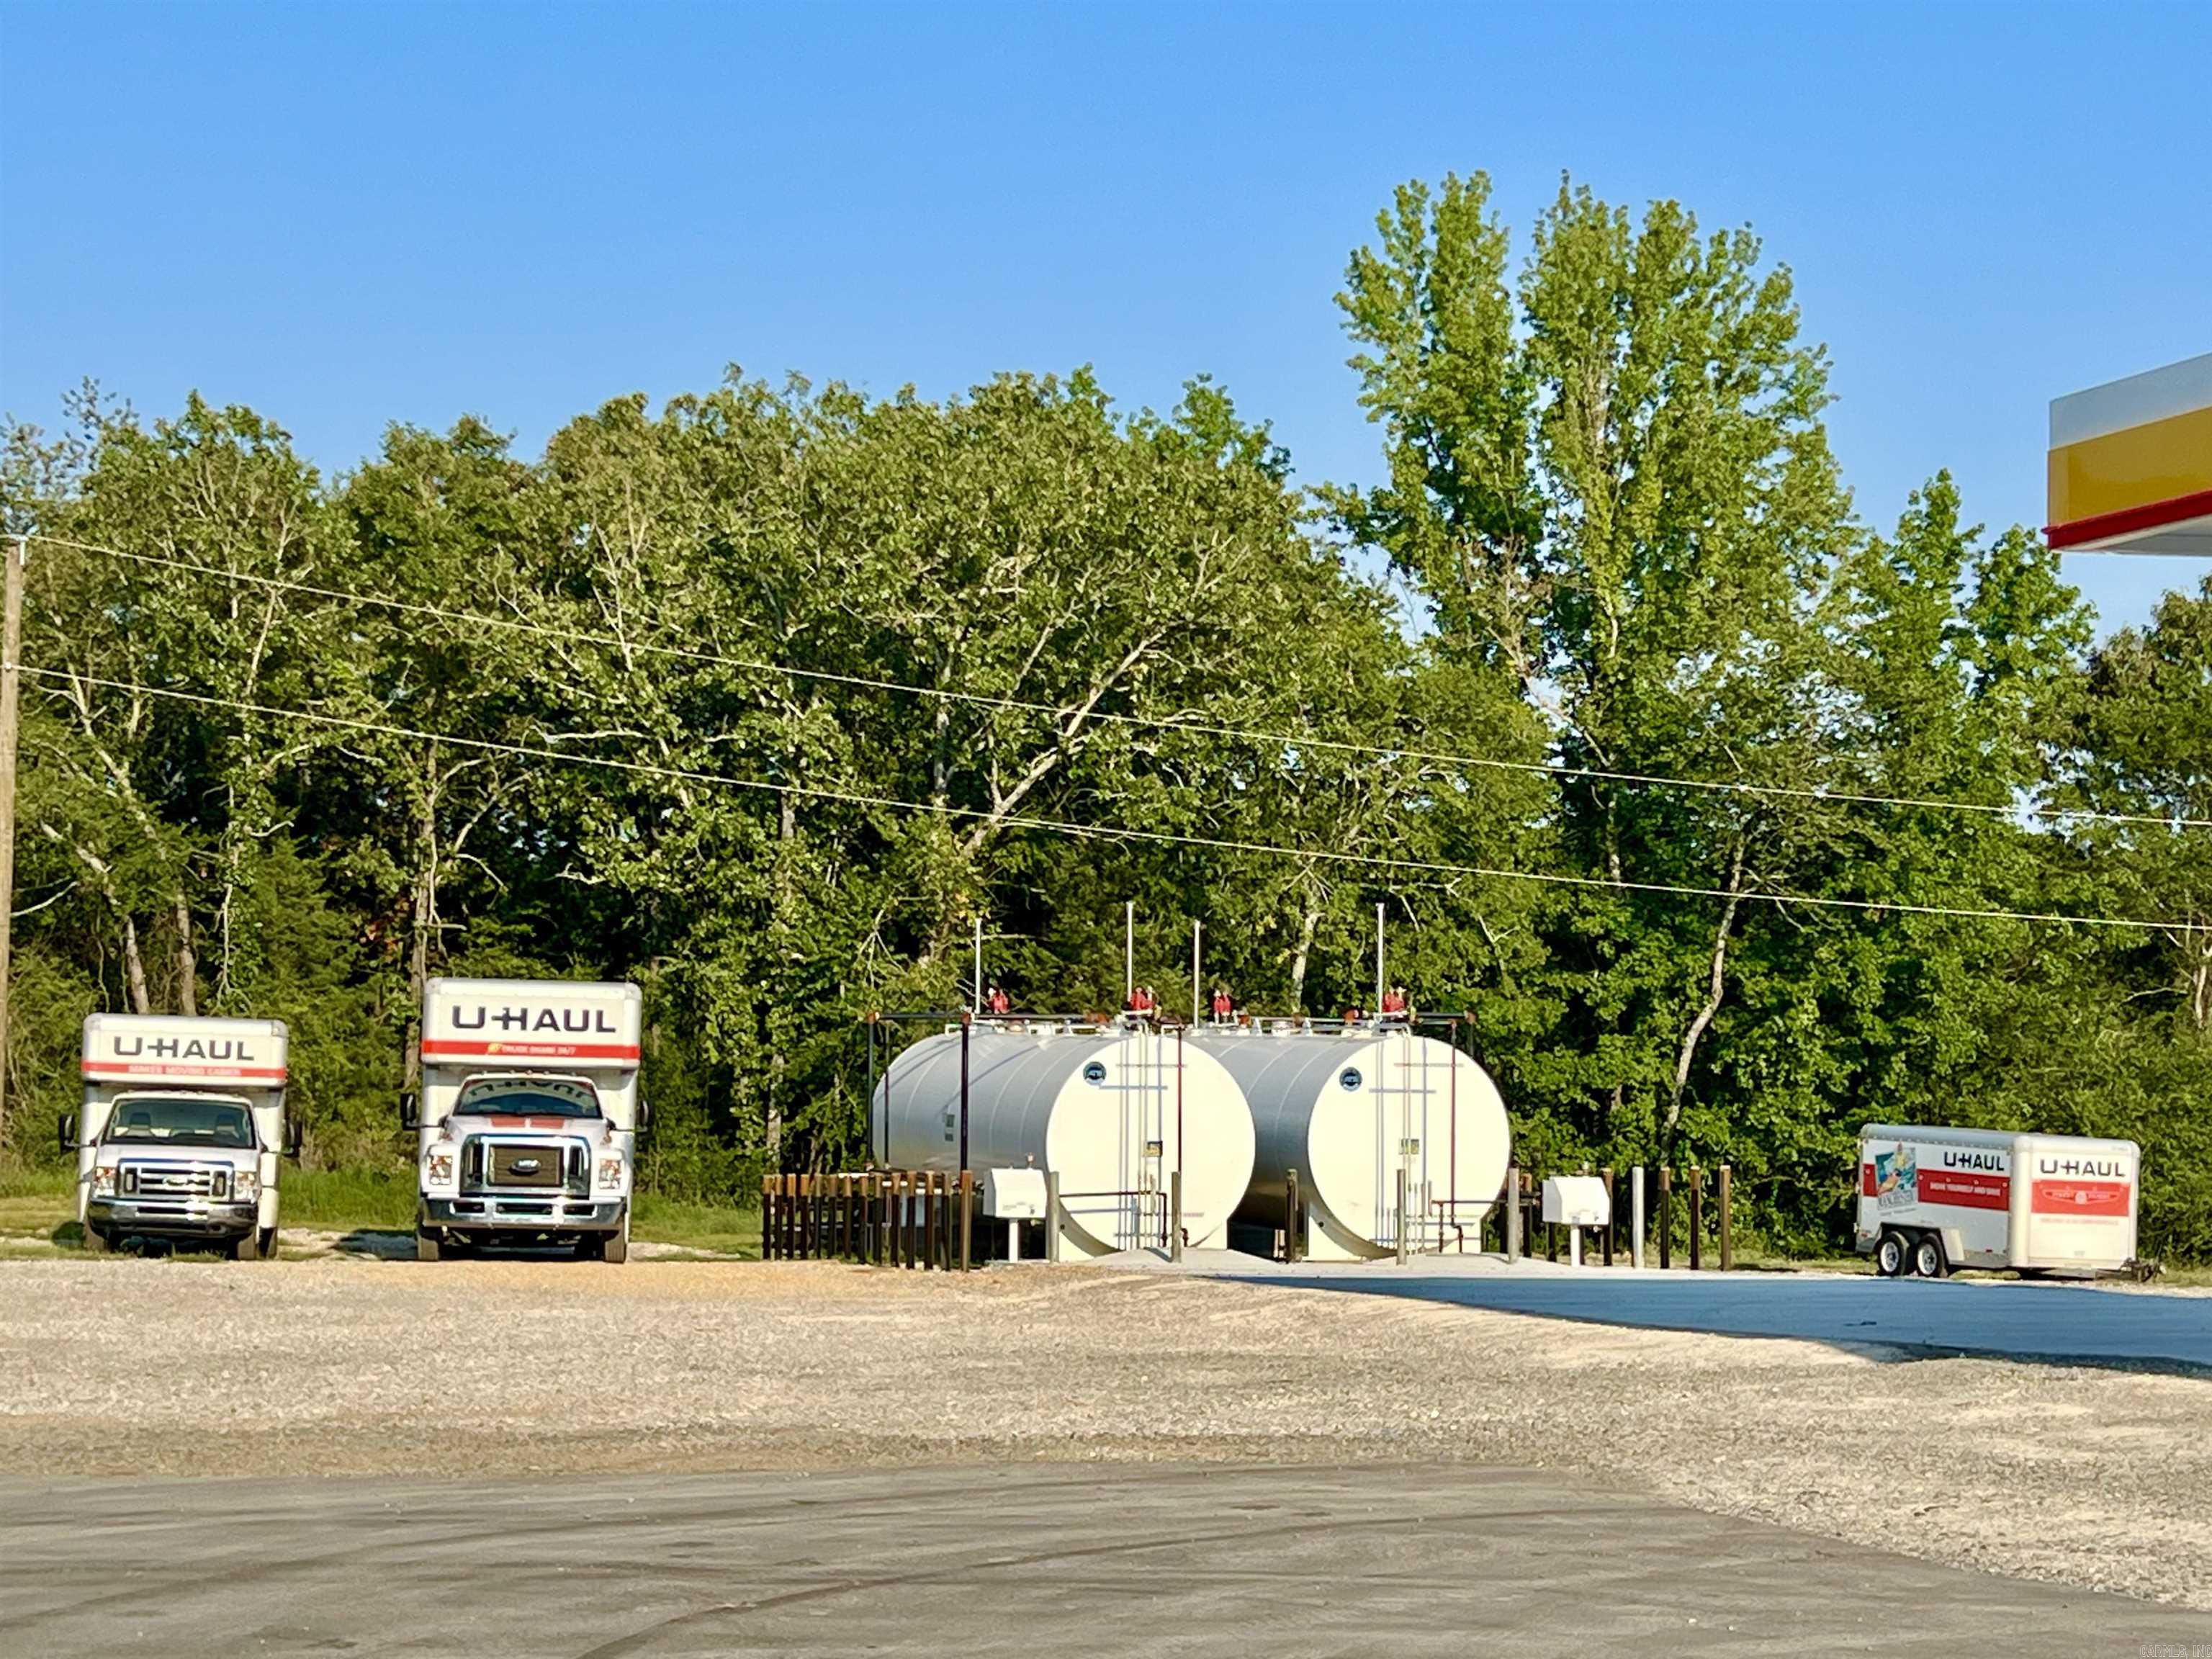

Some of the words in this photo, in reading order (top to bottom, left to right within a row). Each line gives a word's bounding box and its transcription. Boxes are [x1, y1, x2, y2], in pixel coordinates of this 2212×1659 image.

[451, 1005, 616, 1033] U-HAUL
[113, 1035, 255, 1061] U-HAUL
[1944, 1151, 2005, 1172] U-HAUL
[2040, 1159, 2126, 1177] U-HAUL
